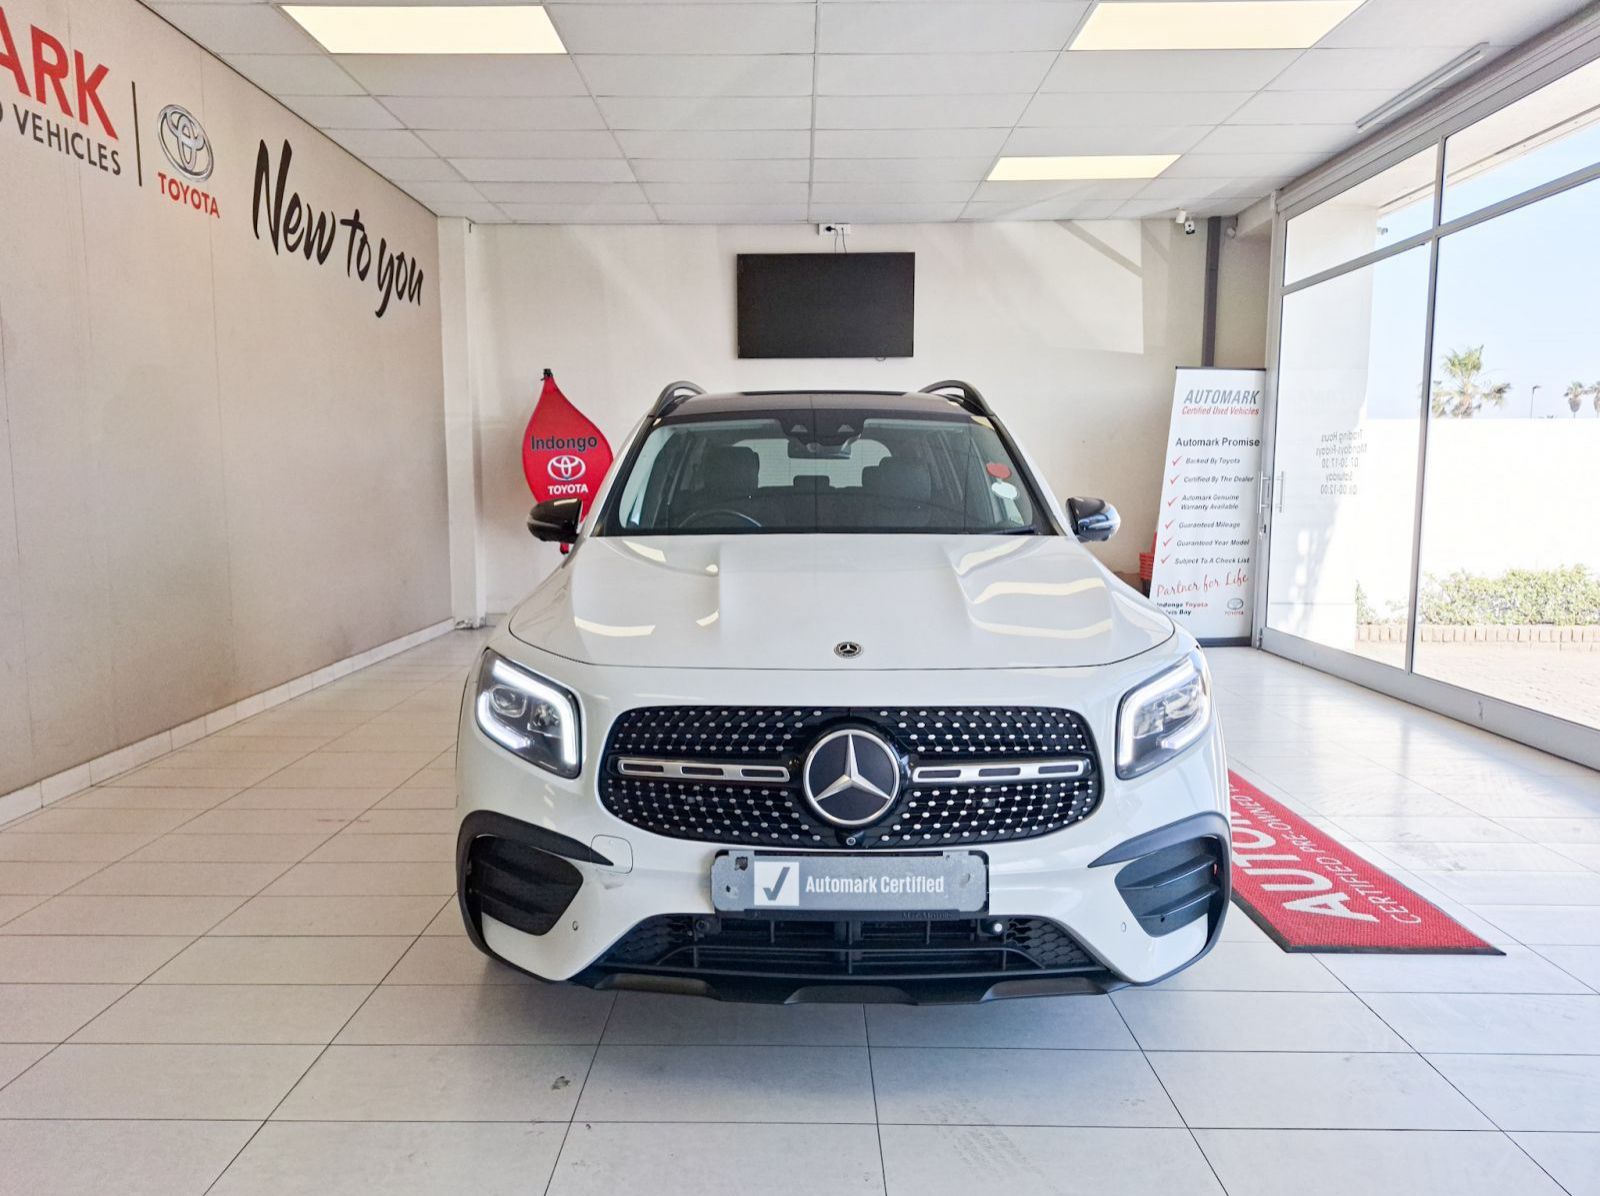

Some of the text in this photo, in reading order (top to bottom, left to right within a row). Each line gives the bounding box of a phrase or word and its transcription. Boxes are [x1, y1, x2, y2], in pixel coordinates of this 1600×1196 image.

[13, 103, 121, 176] VEHICLES
[157, 172, 220, 219] TOYOTA
[252, 138, 424, 318] New to you
[1184, 389, 1260, 404] AUTOMARK
[1182, 406, 1260, 415] Certified Used Vehicles
[531, 435, 597, 451] Indongo
[1175, 437, 1260, 447] Automark Promise
[1210, 457, 1218, 466] By
[1220, 457, 1241, 465] Toyota
[1210, 476, 1218, 485] By
[547, 483, 588, 495] TOYOTA
[1180, 503, 1209, 511] Warranty
[1178, 521, 1241, 530] Guaranteed Mileage
[1176, 539, 1213, 547] Guaranteed
[1175, 557, 1199, 565] Subject
[1156, 568, 1249, 597] Partner for Life
[1231, 811, 1380, 923] AUTO
[805, 875, 945, 893] Automark Certified
[1315, 856, 1422, 924] CERTIFIED
